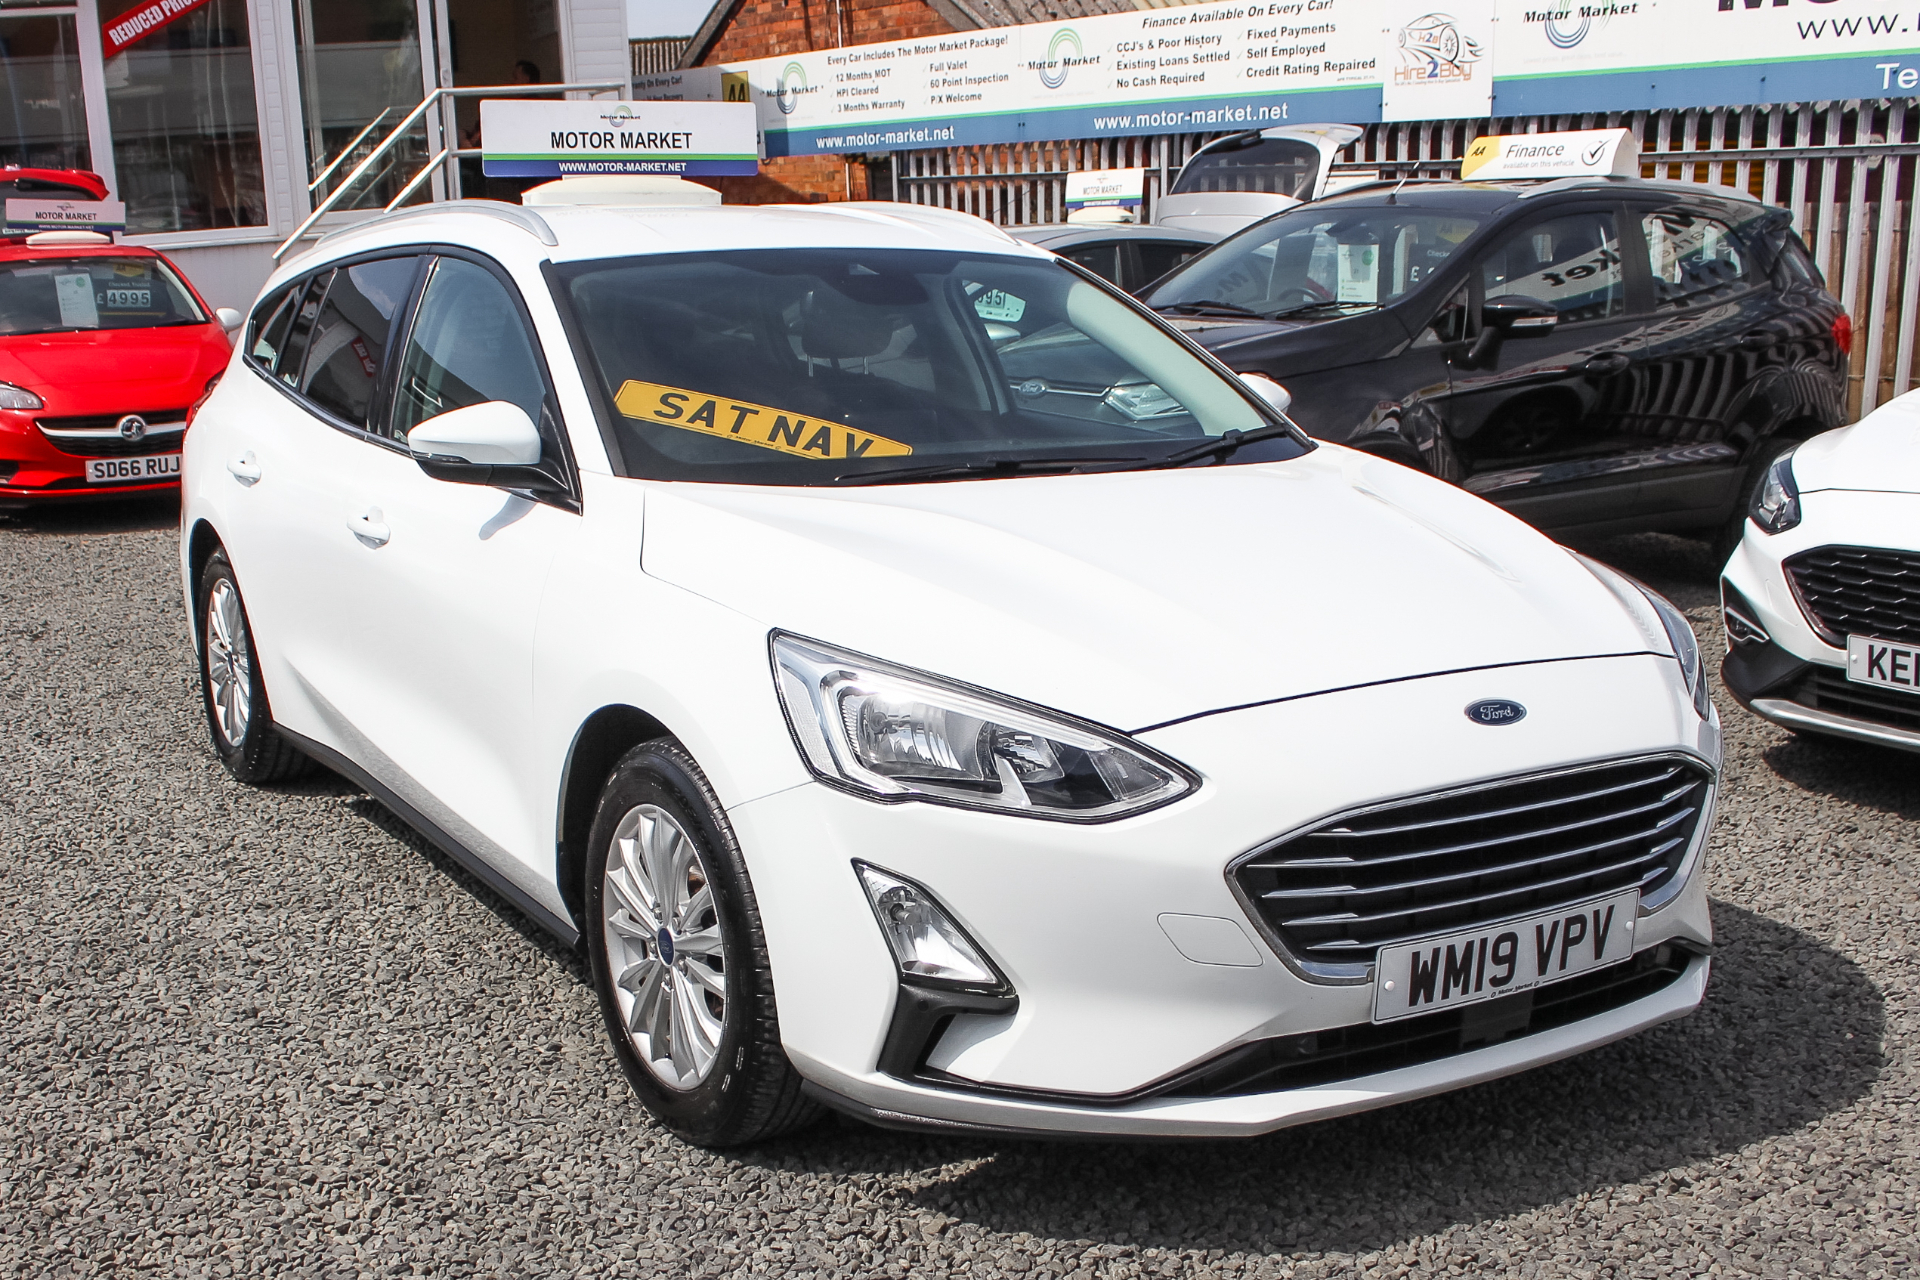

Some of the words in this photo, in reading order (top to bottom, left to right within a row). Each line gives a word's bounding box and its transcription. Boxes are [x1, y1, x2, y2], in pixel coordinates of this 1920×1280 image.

[1142, 17, 1186, 29] Finance
[1190, 9, 1244, 24] Available
[1247, 7, 1264, 18] On
[1268, 2, 1304, 16] Every
[1307, 0, 1333, 11] Car!
[1523, 10, 1572, 23] Motor
[1578, 3, 1639, 18] Market
[108, 5, 165, 46] REDUCED
[1247, 28, 1277, 40] Fixed
[1280, 22, 1336, 40] Payments
[1797, 13, 1920, 39] www.
[827, 56, 847, 66] Every
[849, 53, 862, 62] Car
[864, 49, 895, 61] Includes
[897, 47, 912, 57] The
[914, 44, 937, 55] Motor
[939, 41, 967, 52] Market
[970, 35, 1008, 50] Package!
[1116, 41, 1144, 52] CCJ's
[1148, 40, 1154, 49] &
[1158, 38, 1181, 48] Poor
[1184, 34, 1222, 46] History
[1247, 46, 1268, 59] Self
[1271, 42, 1326, 58] Employed
[930, 63, 945, 72] Full
[946, 60, 968, 71] Valet
[1027, 59, 1058, 70] Motor
[1062, 55, 1101, 67] Market
[1116, 60, 1156, 71] Existing
[1159, 56, 1189, 67] Loans
[1193, 51, 1230, 64] Settled
[1246, 65, 1280, 78] Credit
[1283, 62, 1320, 76] Rating
[1324, 58, 1376, 73] Repaired
[836, 73, 844, 82] 12
[846, 71, 872, 81] Months
[875, 68, 891, 78] MOT
[1394, 60, 1472, 81] Hire2Buy
[930, 79, 940, 88] 60
[942, 77, 963, 87] Point
[965, 73, 1009, 86] Inspection
[1116, 78, 1130, 88] No
[1132, 75, 1157, 87] Cash
[1160, 71, 1205, 86] Required
[766, 89, 788, 98] Motor
[791, 85, 818, 95] Market
[836, 88, 849, 98] HPI
[850, 85, 879, 96] Cleared
[945, 92, 982, 104] Welcome
[837, 104, 842, 112] 3
[843, 102, 869, 112] Months
[871, 99, 905, 111] Warranty
[1093, 102, 1288, 130] www.motor-market.net
[550, 131, 615, 150] MOTOR
[620, 132, 693, 150] MARKET
[816, 125, 955, 149] www.motor-market.net
[1471, 146, 1486, 157] AA
[1506, 144, 1565, 158] Finance
[559, 162, 687, 173] WWW.MOTOR-MARKET.NET
[1503, 160, 1529, 169] available
[1541, 160, 1551, 168] this
[1552, 159, 1575, 167] vehicle
[35, 211, 64, 220] MOTOR
[65, 212, 97, 221] MARKET
[653, 392, 760, 435] SAT
[766, 415, 875, 458] NAV
[94, 460, 141, 479] SD66
[145, 456, 180, 475] RUJ
[1480, 704, 1515, 721] Ford
[1408, 931, 1519, 1007] WM19
[1535, 904, 1616, 977] VPV
